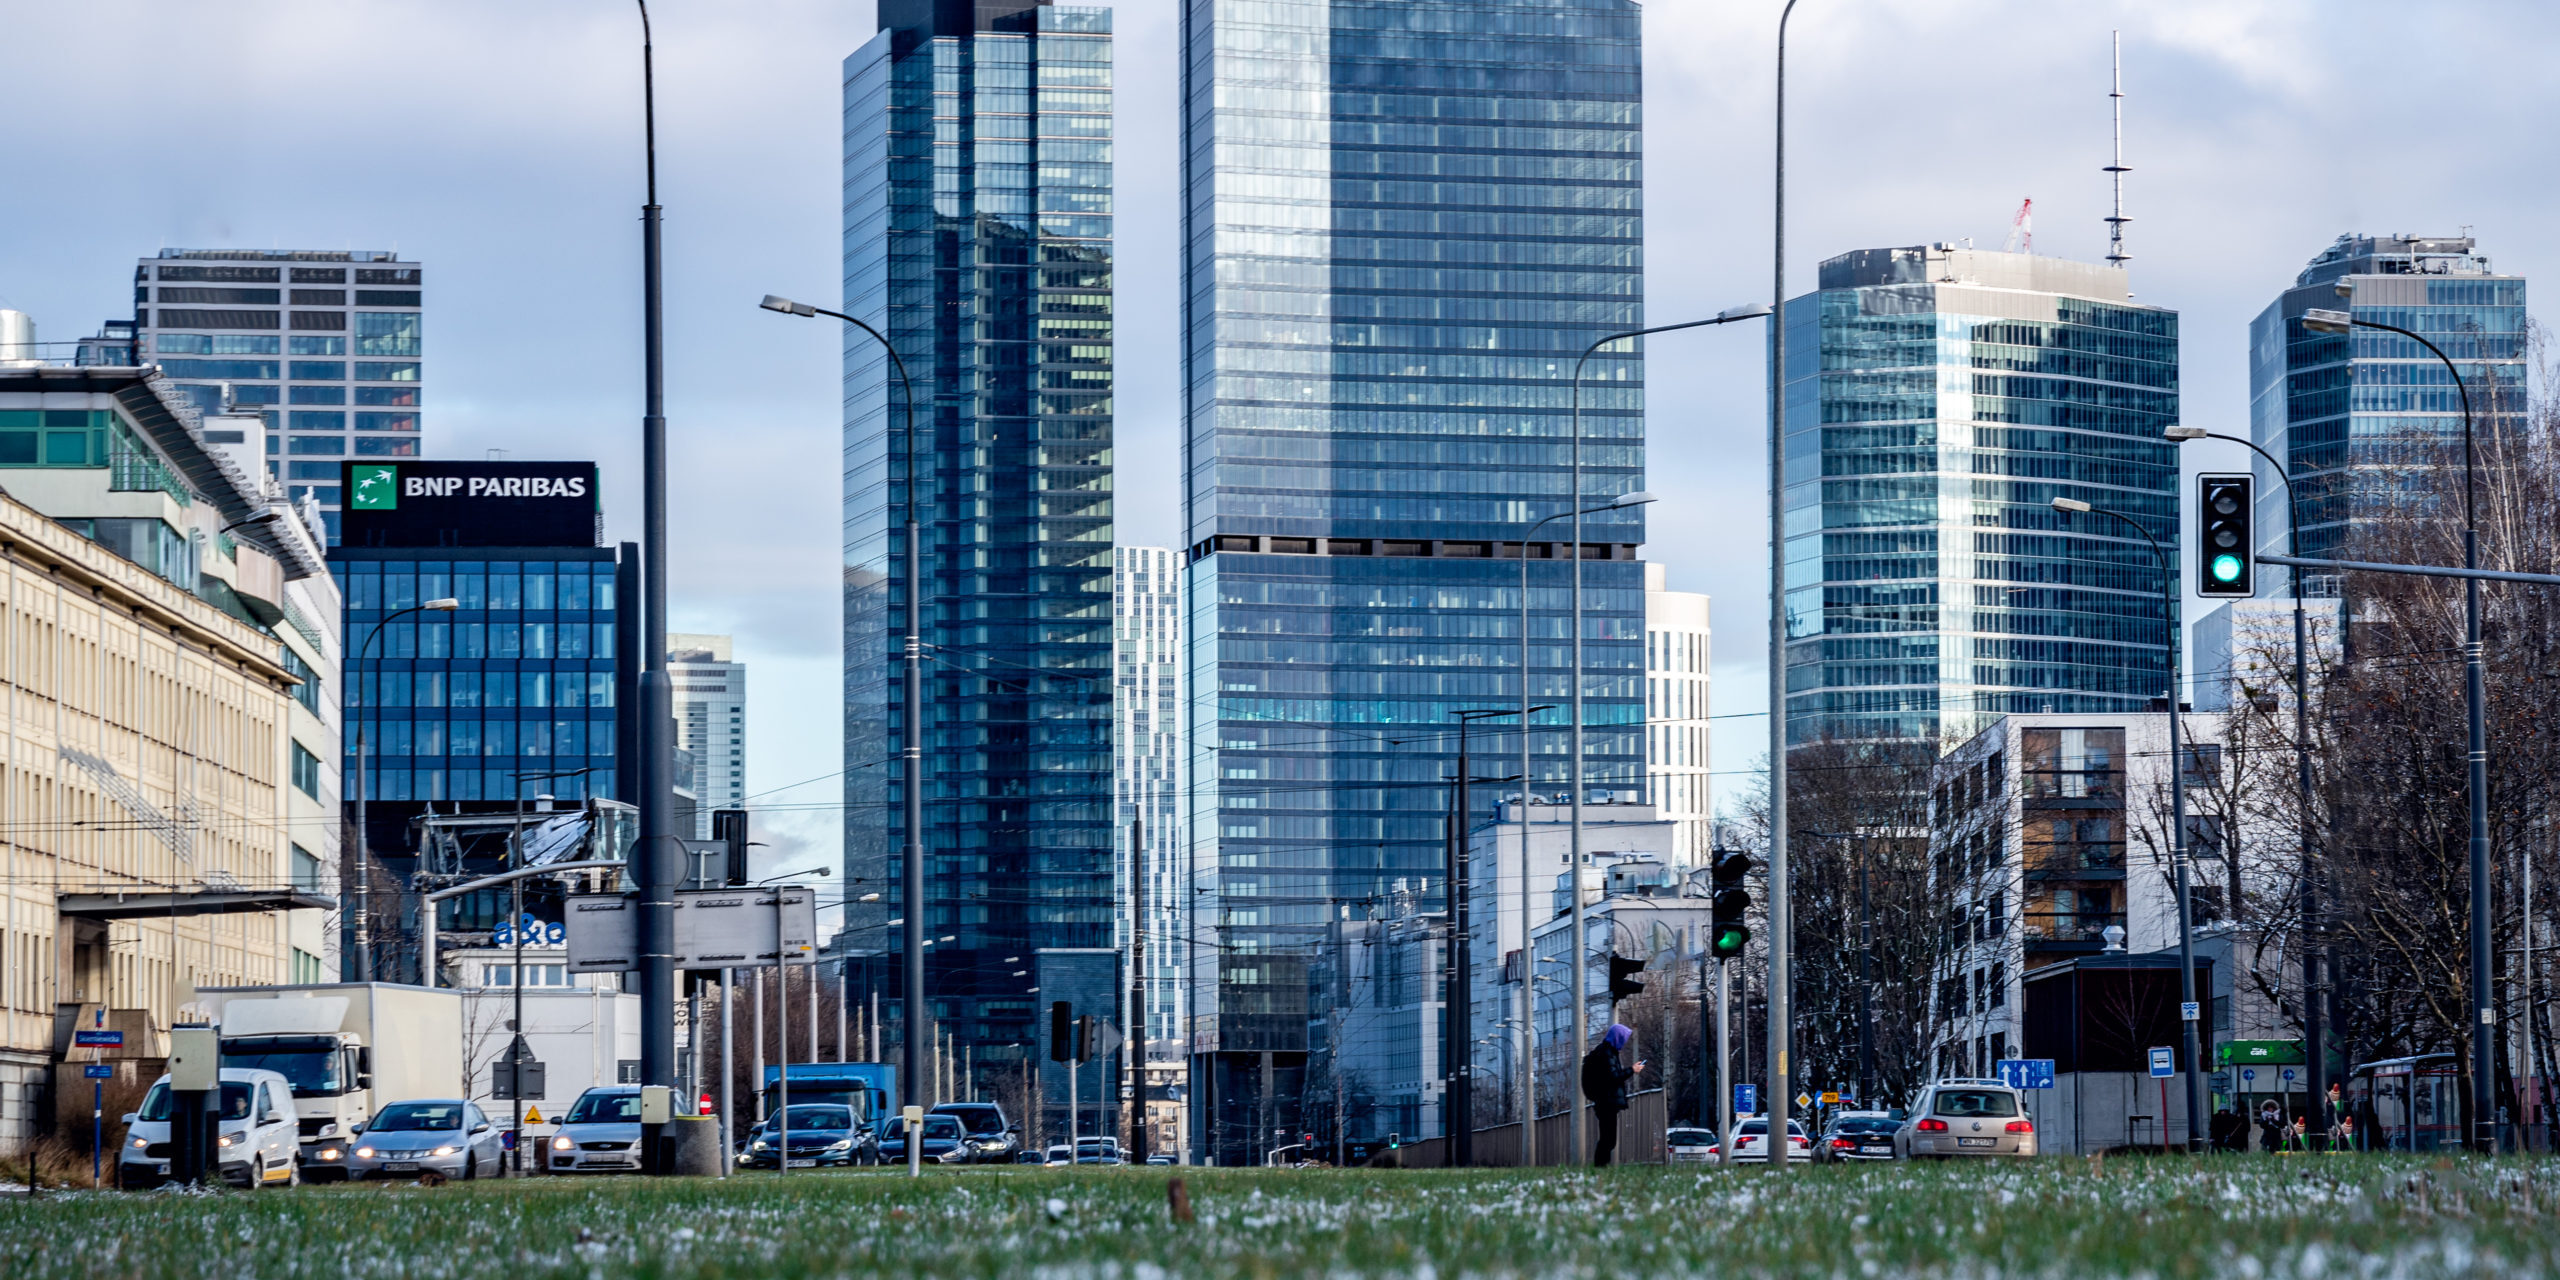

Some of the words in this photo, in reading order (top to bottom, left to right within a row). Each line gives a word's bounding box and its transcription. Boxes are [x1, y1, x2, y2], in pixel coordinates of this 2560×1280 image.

[405, 477, 463, 497] BNP
[468, 477, 586, 498] PARIBAS
[493, 912, 566, 944] a&o
